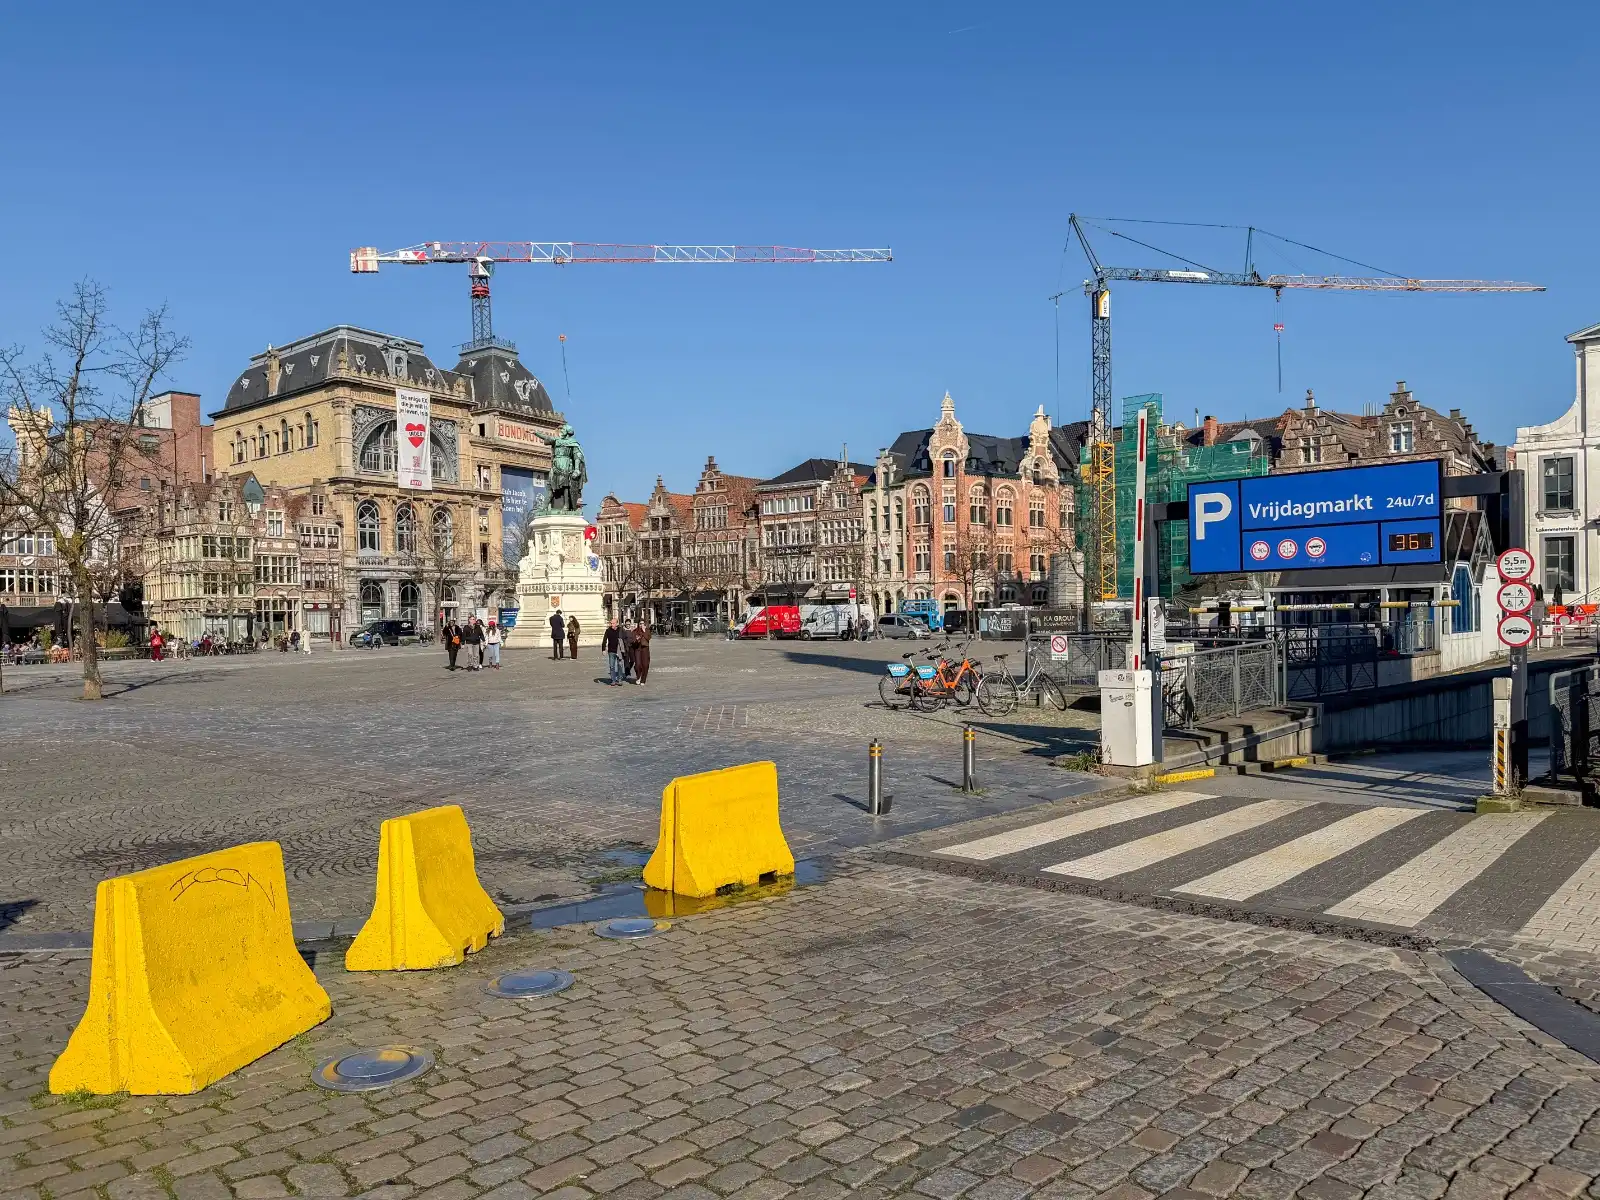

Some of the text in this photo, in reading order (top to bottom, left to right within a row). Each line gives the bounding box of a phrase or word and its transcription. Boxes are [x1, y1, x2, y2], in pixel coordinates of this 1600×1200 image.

[1195, 493, 1232, 540] P
[1249, 493, 1434, 521] Vrijdagmarkt 24u/7d
